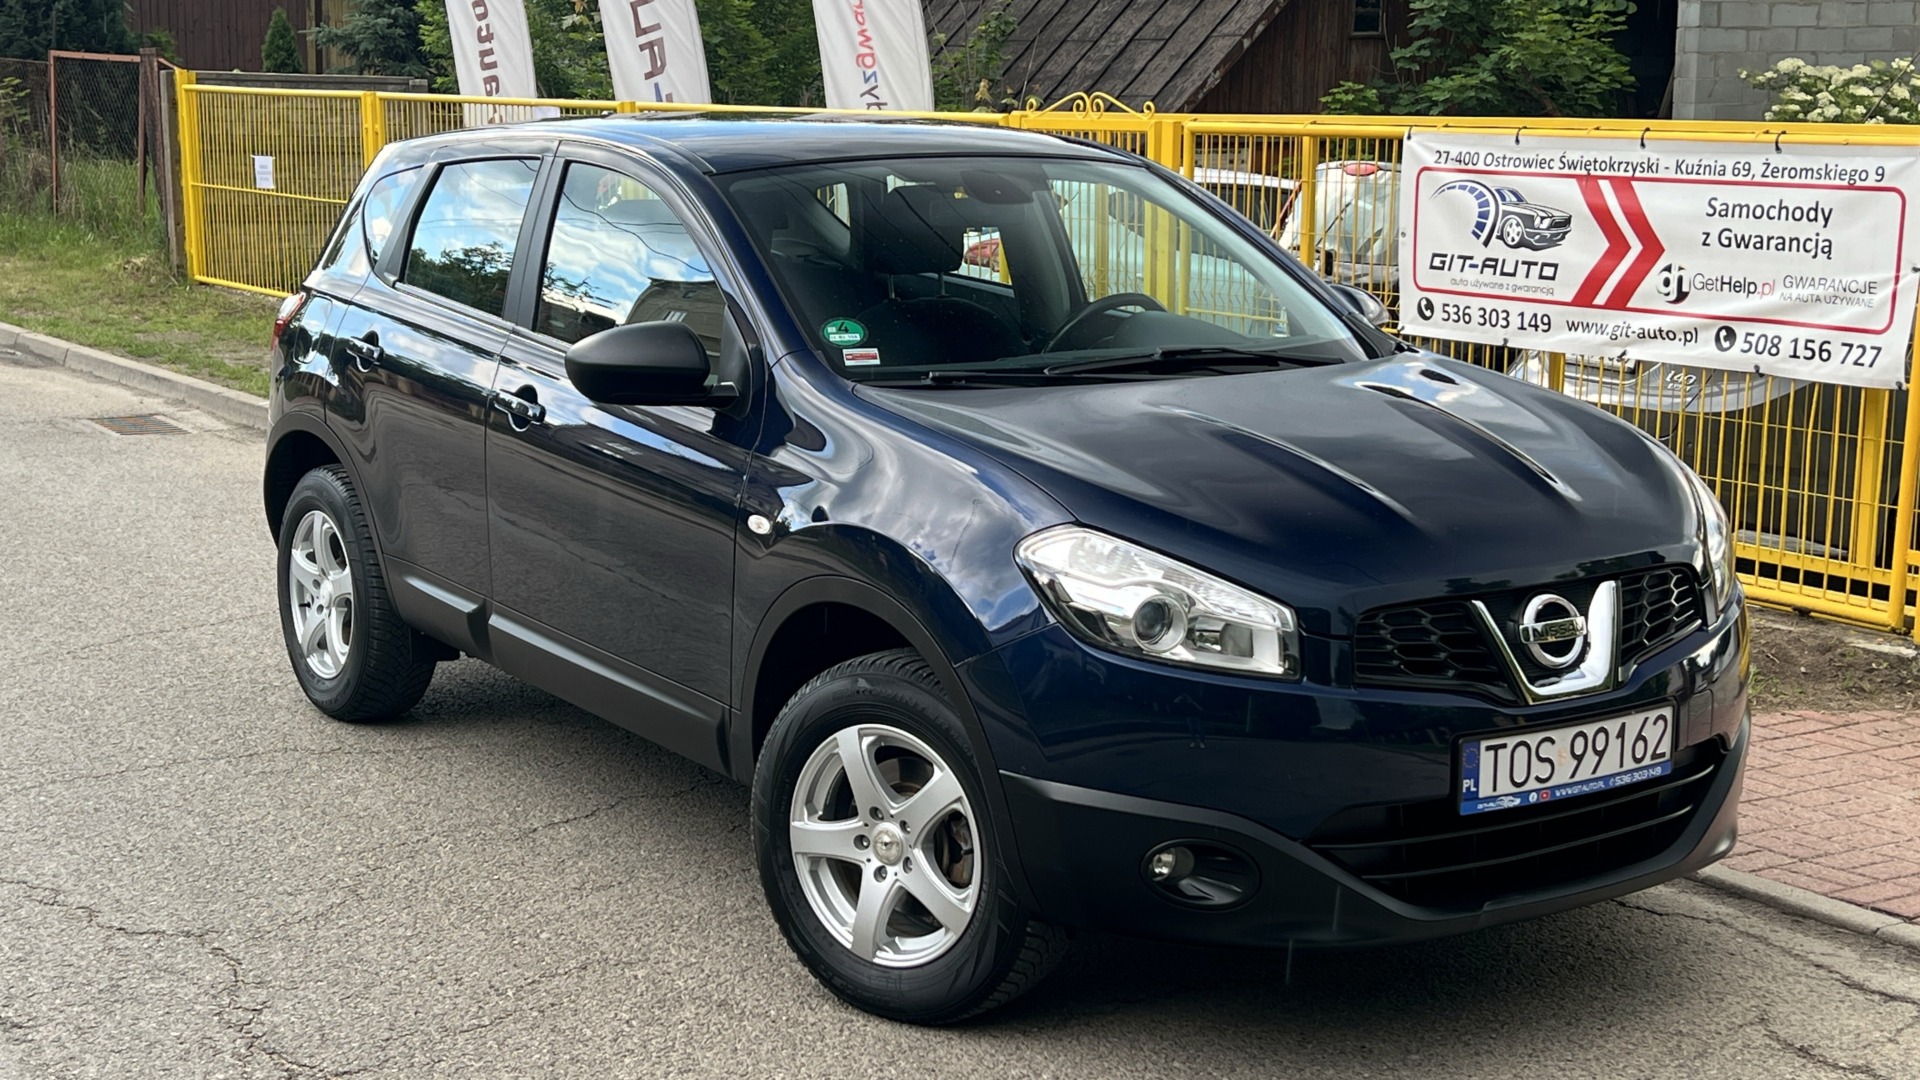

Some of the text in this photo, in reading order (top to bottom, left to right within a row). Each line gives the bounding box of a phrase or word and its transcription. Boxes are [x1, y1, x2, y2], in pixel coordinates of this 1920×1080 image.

[1434, 150, 1480, 167] 27-400
[1483, 151, 1555, 171] Ostrowiec
[1558, 151, 1660, 178] Świętokrzyski
[1675, 158, 1726, 177] Kuźnia
[1731, 160, 1756, 181] 69,
[1761, 157, 1869, 186] Żeromskiego
[1874, 165, 1885, 183] 9
[1705, 196, 1834, 229] Samochody
[1701, 227, 1833, 260] z Gwarancją
[1428, 252, 1560, 282] GIT-AUTO
[1450, 278, 1468, 287] auta
[1692, 272, 1776, 298] GetHelp.pl
[1783, 274, 1878, 296] GWARANCJE
[1795, 292, 1822, 304] AUTA
[837, 321, 849, 334] 4
[1441, 302, 1551, 333] 536 303 149
[1566, 318, 1882, 369] www.git-auto.pl 508 156 727
[1462, 713, 1669, 793] PL TOS 99162
